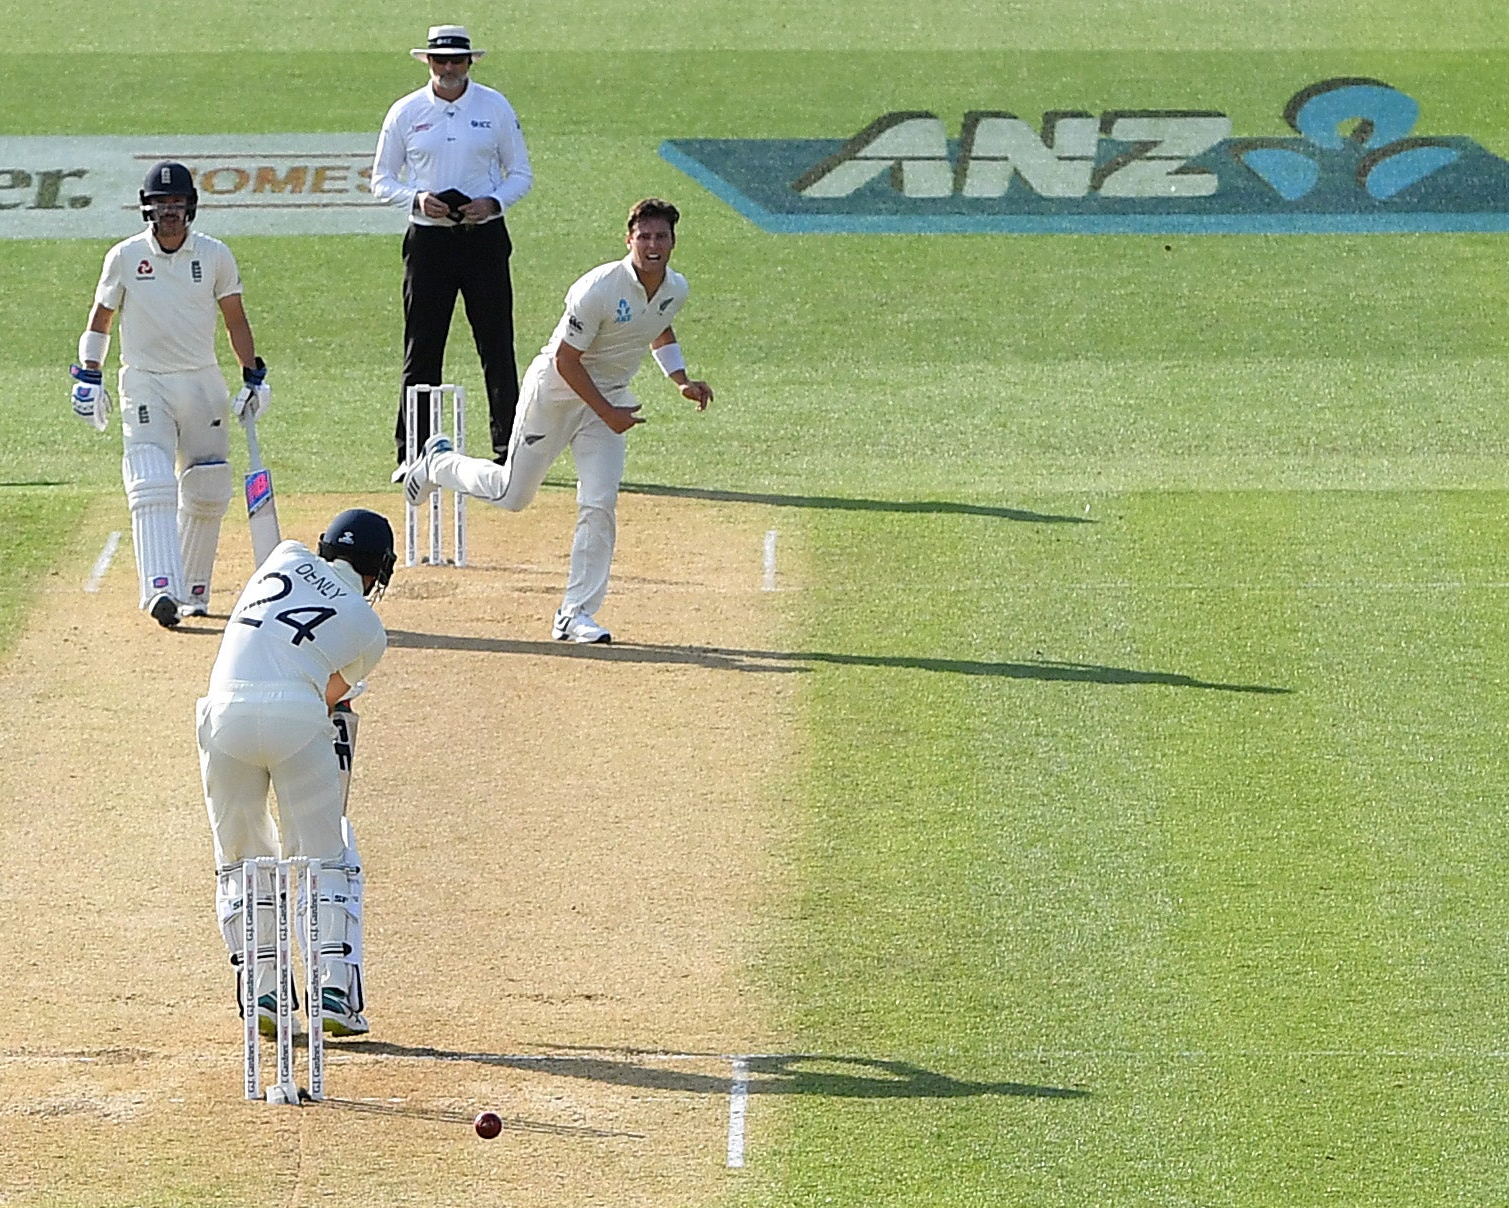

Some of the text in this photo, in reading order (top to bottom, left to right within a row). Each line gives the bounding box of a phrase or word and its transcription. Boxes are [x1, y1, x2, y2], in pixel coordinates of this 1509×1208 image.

[791, 111, 1233, 199] ANZ
[233, 572, 338, 646] 24
[295, 563, 348, 600] DENLY
